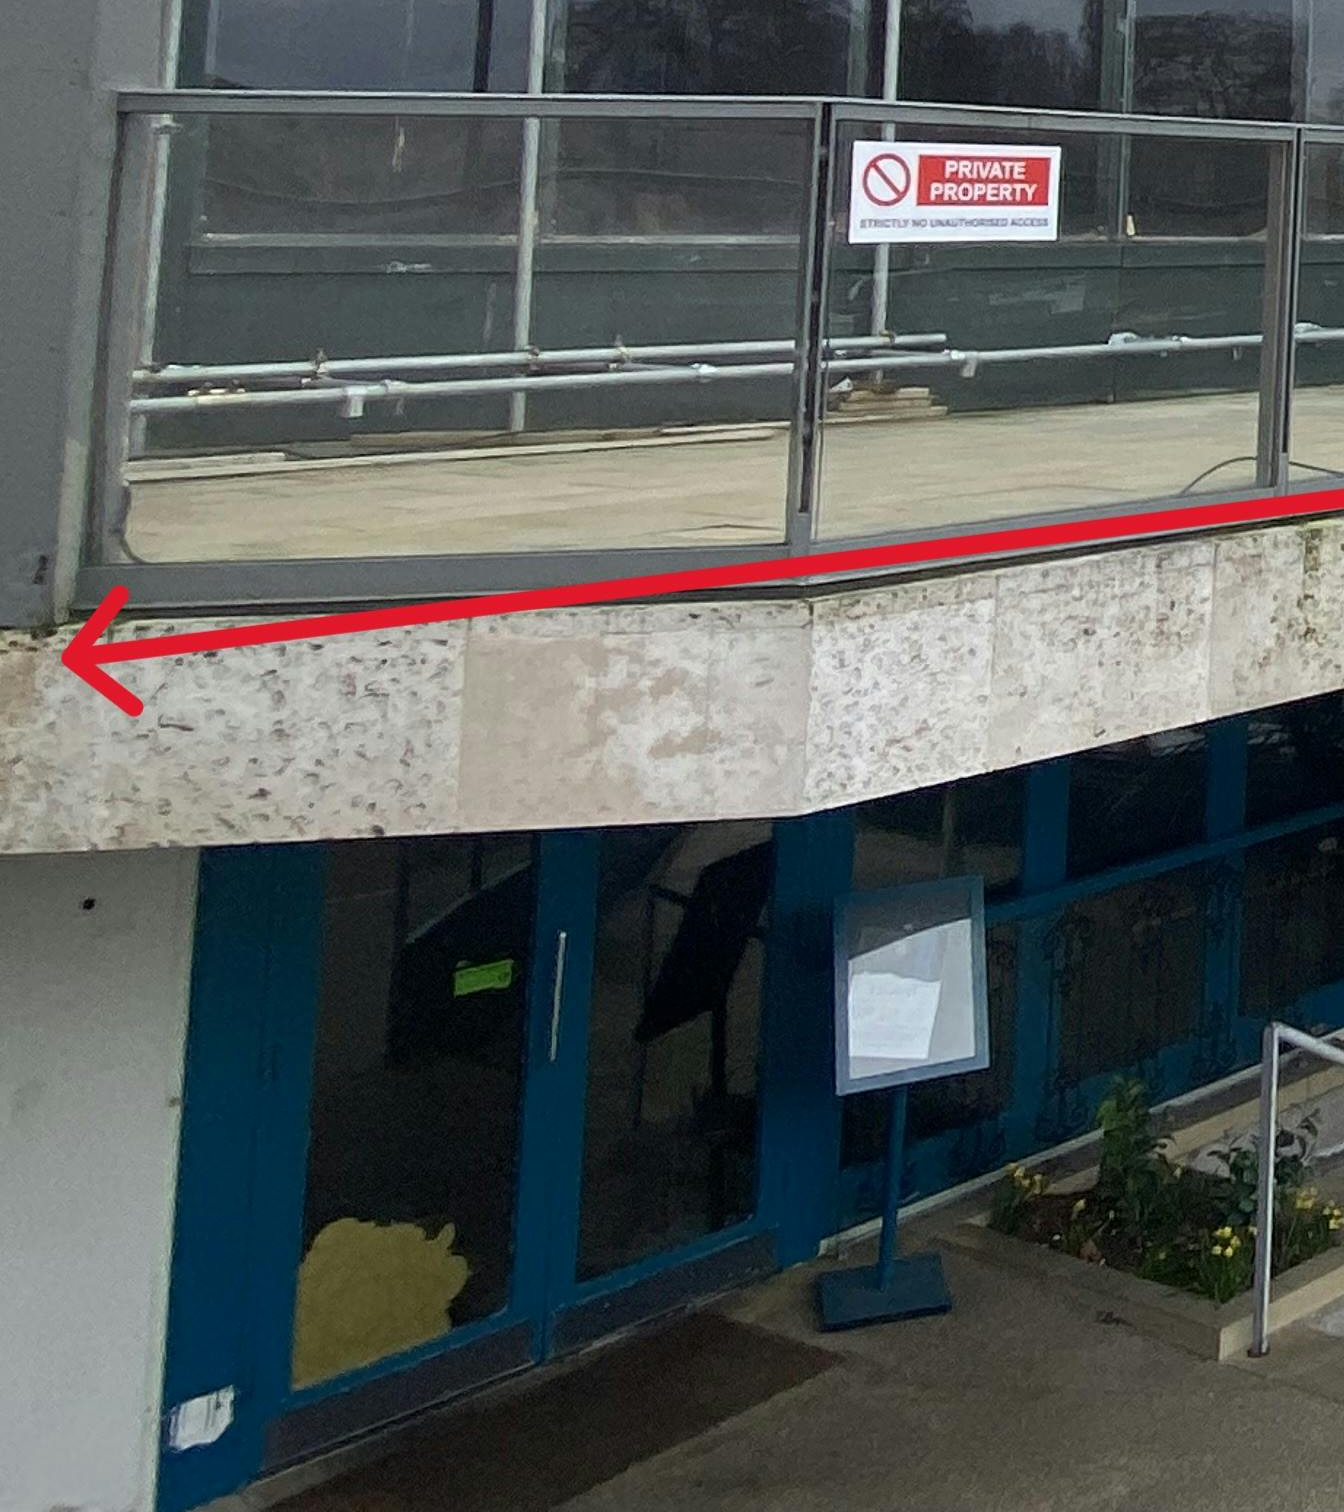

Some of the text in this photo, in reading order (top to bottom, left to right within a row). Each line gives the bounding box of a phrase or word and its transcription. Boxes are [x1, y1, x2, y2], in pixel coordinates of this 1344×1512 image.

[944, 160, 1027, 180] PRIVATE
[929, 183, 1037, 201] PROPERTY
[859, 217, 1049, 229] STRICTLY NO UNAUTHORISED ACCESS
